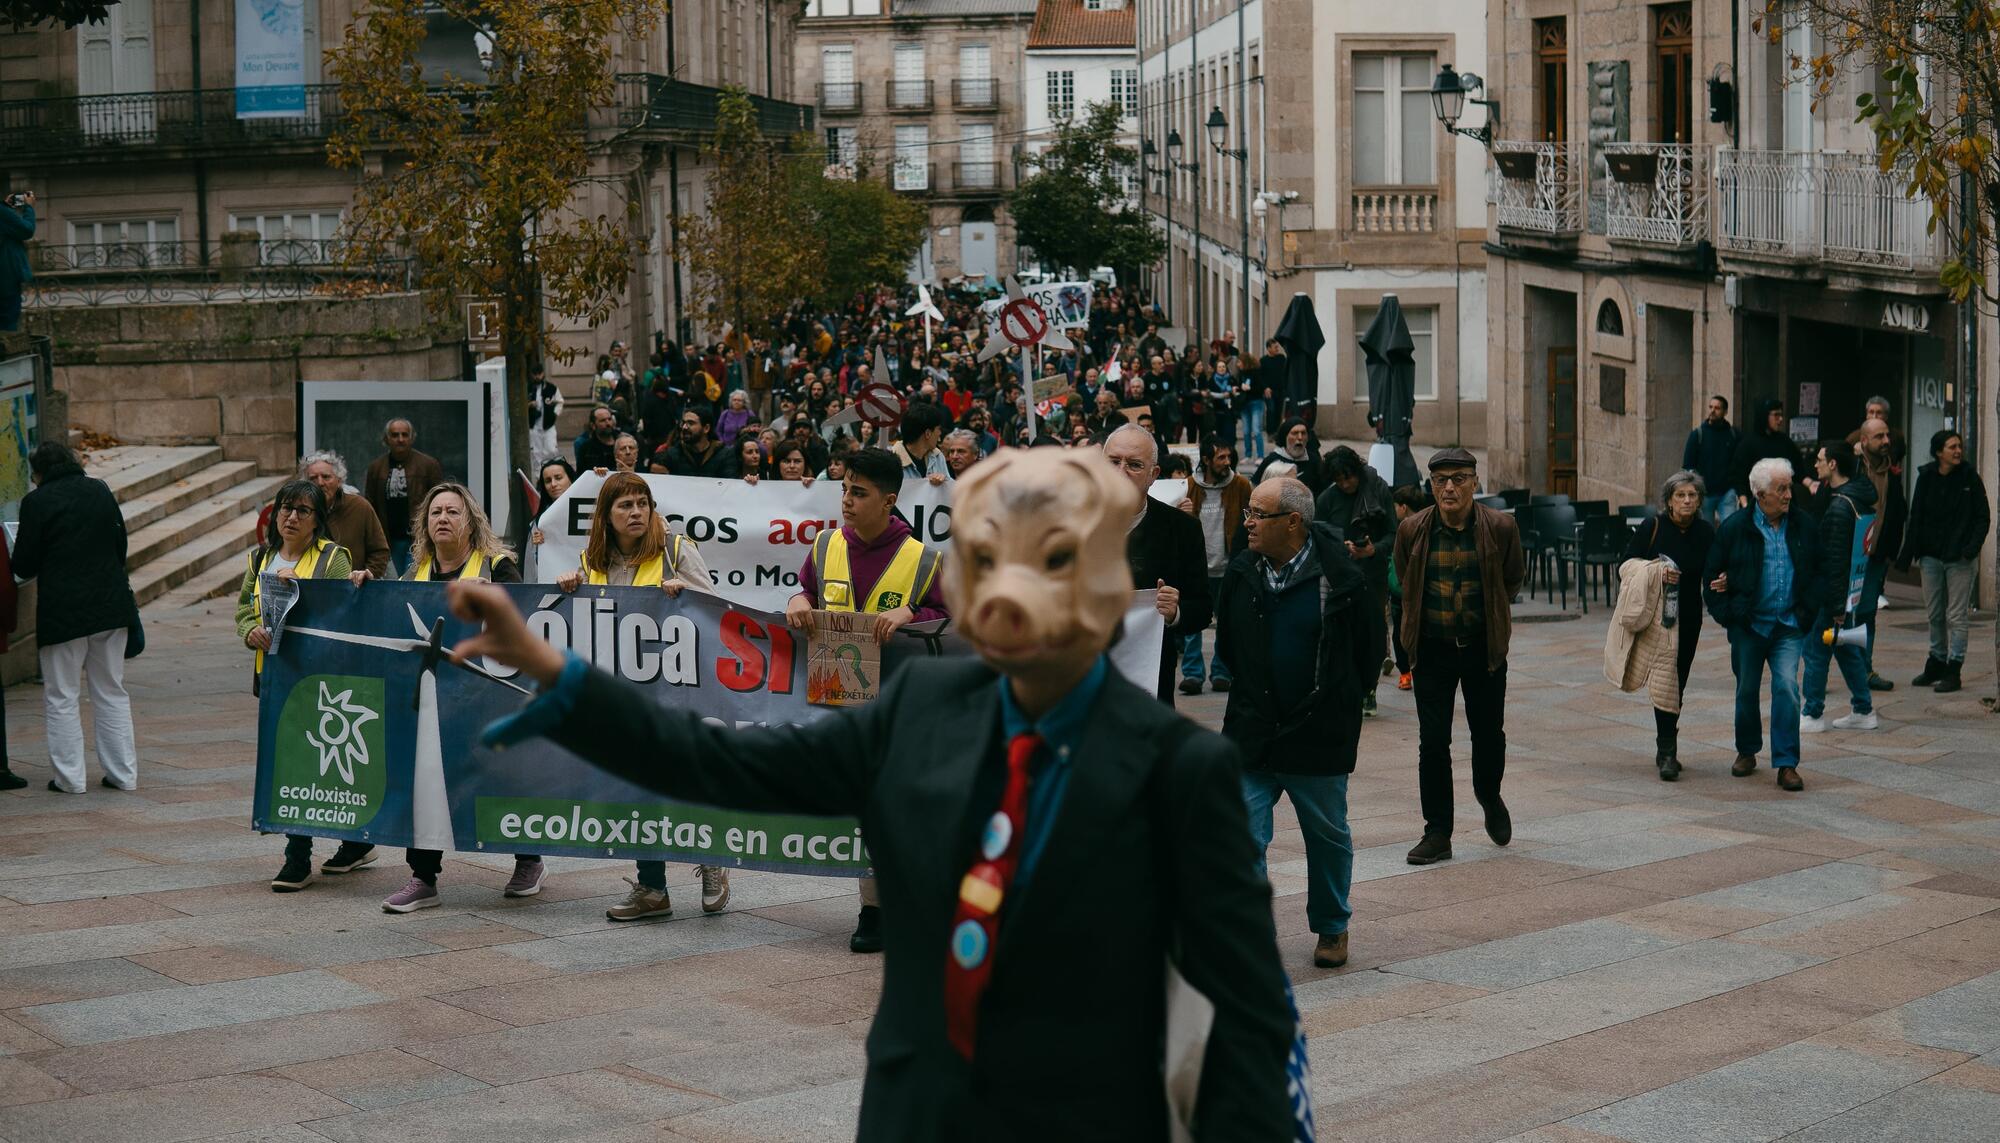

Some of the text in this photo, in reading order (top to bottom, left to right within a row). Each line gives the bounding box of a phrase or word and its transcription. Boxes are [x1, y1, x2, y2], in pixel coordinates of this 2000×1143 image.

[728, 570, 745, 586] o
[755, 564, 798, 586] Mo
[831, 613, 854, 633] NON
[279, 782, 368, 807] ecoloxistas
[278, 804, 357, 825] en acción
[500, 805, 713, 849] ecoloxistas
[725, 827, 768, 855] en
